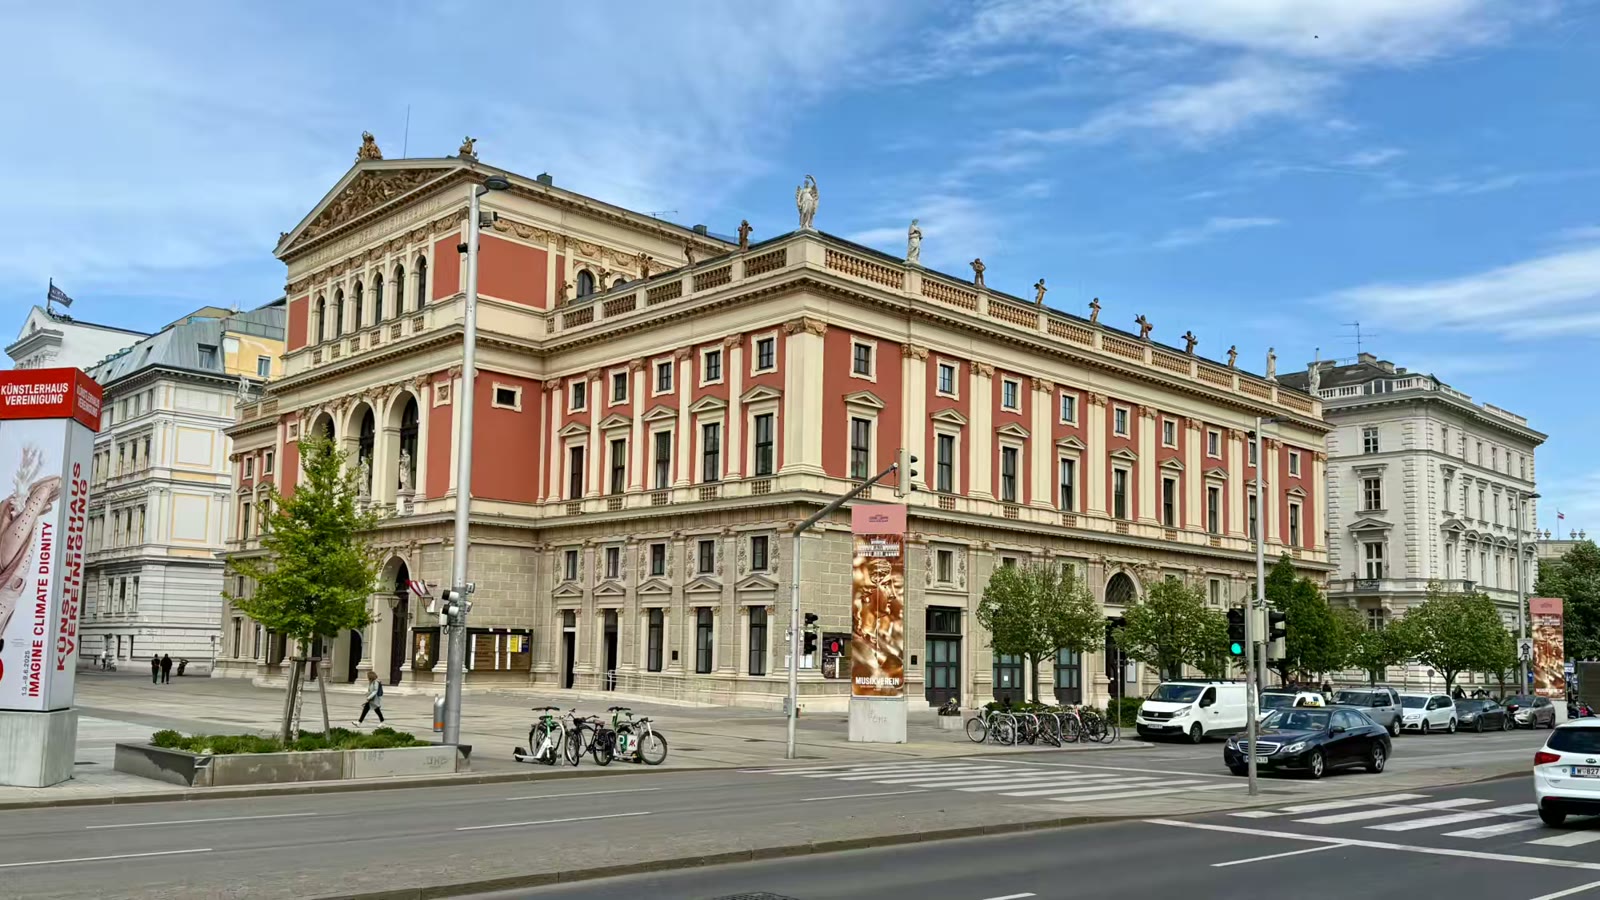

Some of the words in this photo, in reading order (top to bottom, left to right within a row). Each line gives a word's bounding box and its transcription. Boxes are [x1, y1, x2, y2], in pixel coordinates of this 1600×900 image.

[1, 383, 69, 395] KÜNSTLERHAUS
[5, 394, 63, 406] VEREINIGUNG
[38, 522, 53, 574] DIGNITY
[57, 462, 81, 671] KÜNSTLERHAUS
[66, 479, 88, 655] VEREINIGUNG
[33, 578, 48, 636] CLIMATE
[28, 640, 43, 697] IMAGINE
[855, 676, 900, 686] MUSIKVEREIN
